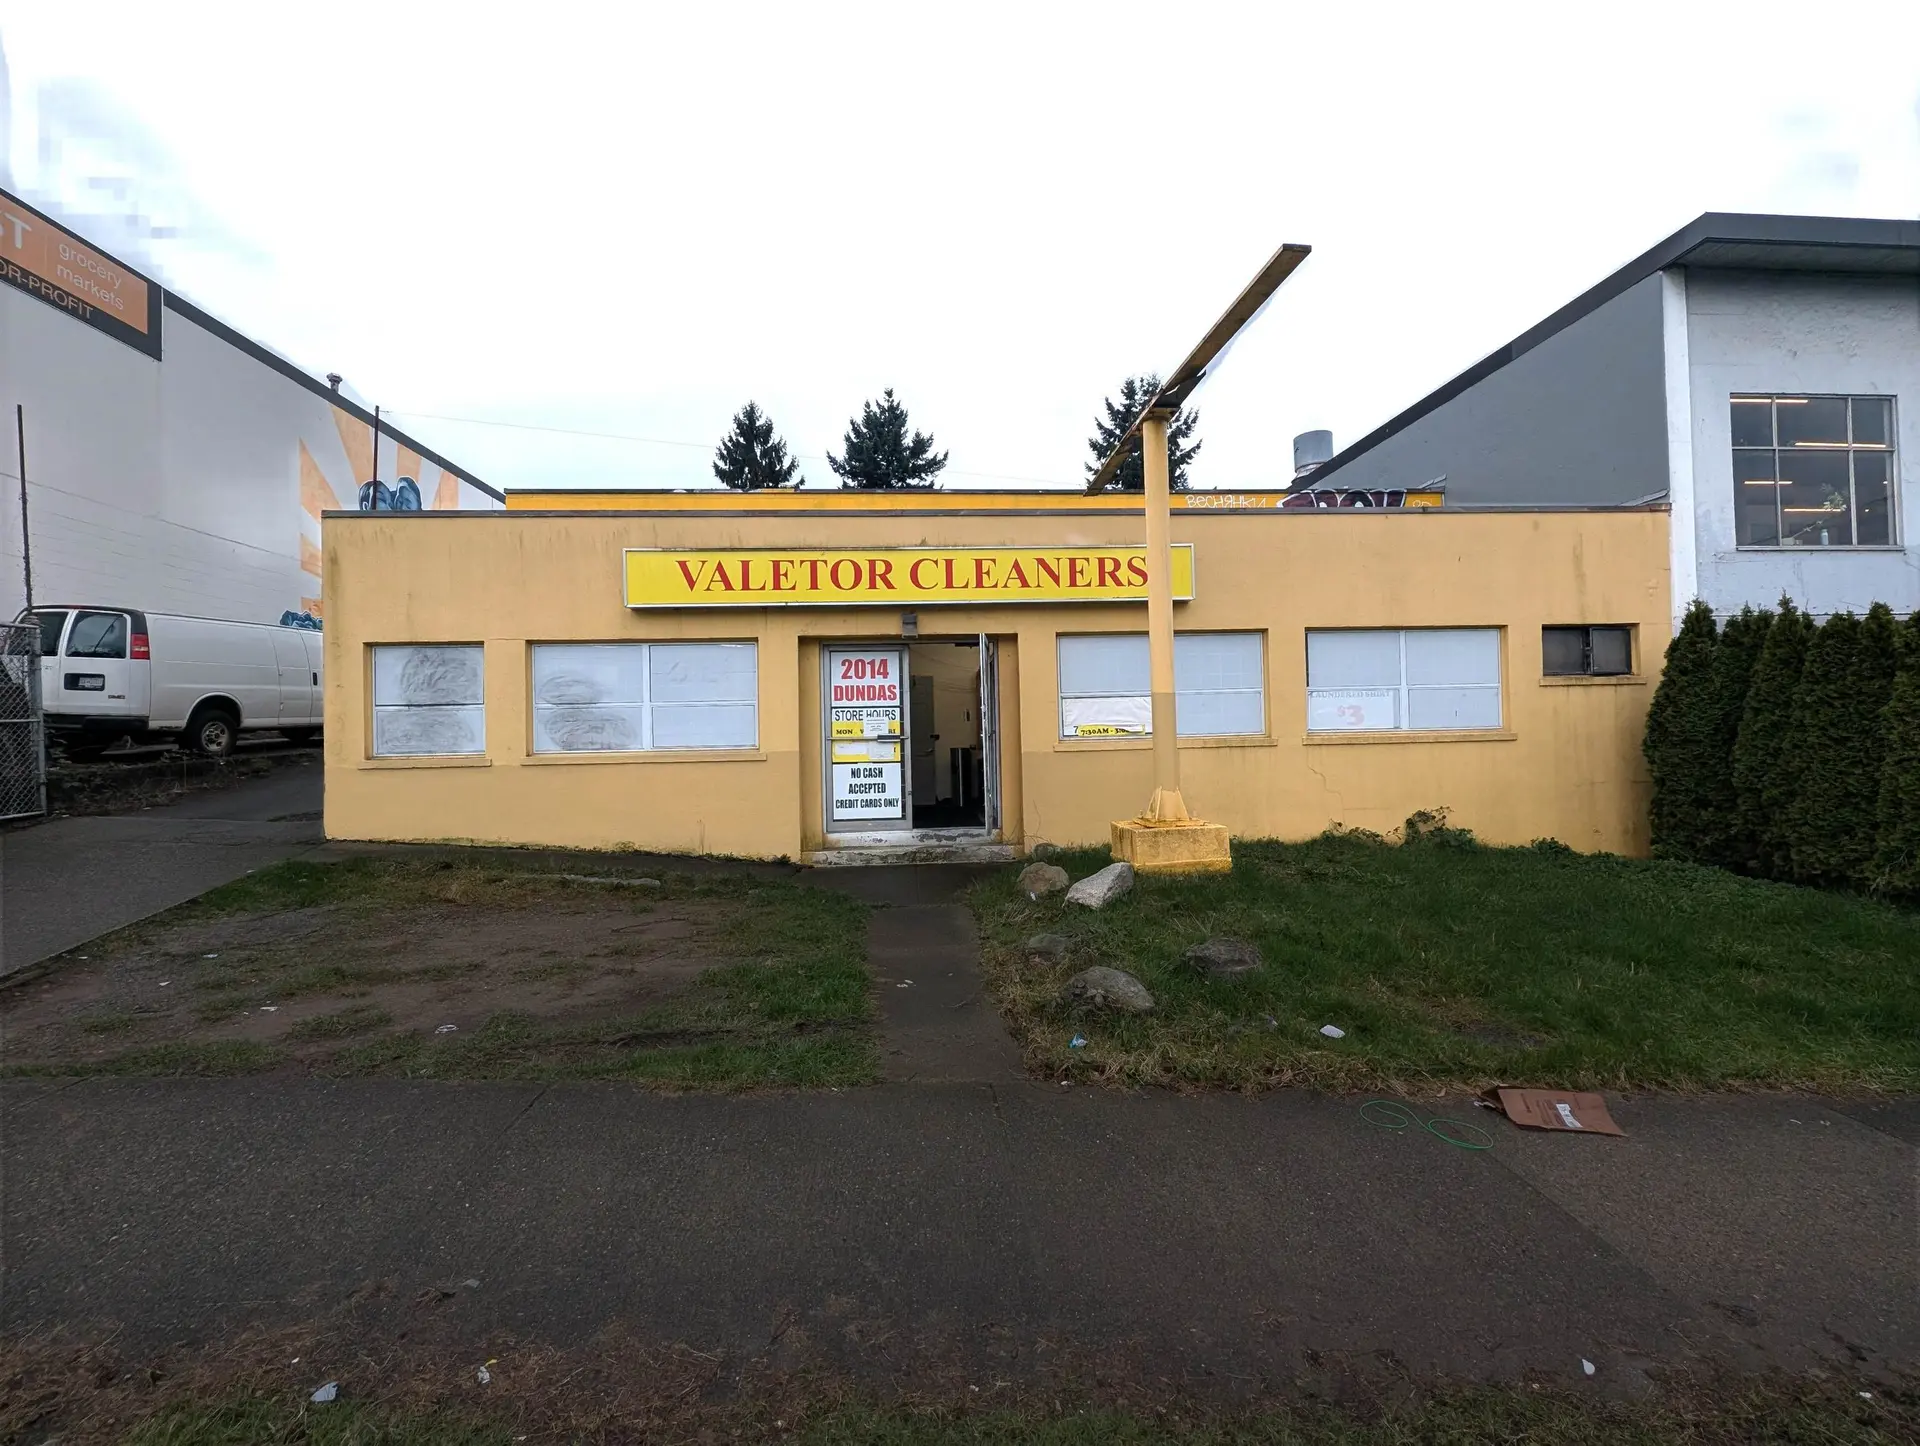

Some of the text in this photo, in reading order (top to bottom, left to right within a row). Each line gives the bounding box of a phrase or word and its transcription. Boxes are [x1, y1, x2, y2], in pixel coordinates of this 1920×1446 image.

[58, 243, 122, 289] grocery
[57, 264, 124, 310] markets
[675, 555, 1149, 592] VALETOR CLEANERS
[841, 658, 889, 680] 2014
[833, 684, 897, 702] DUNDAS
[834, 708, 897, 722] STORE HOURS
[1336, 705, 1365, 726] $3
[1080, 727, 1109, 736] 7:30AM
[850, 767, 883, 779] NO CASH
[848, 782, 887, 795] ACCEPTED
[835, 797, 900, 809] CREDIT CARDS ONLY
